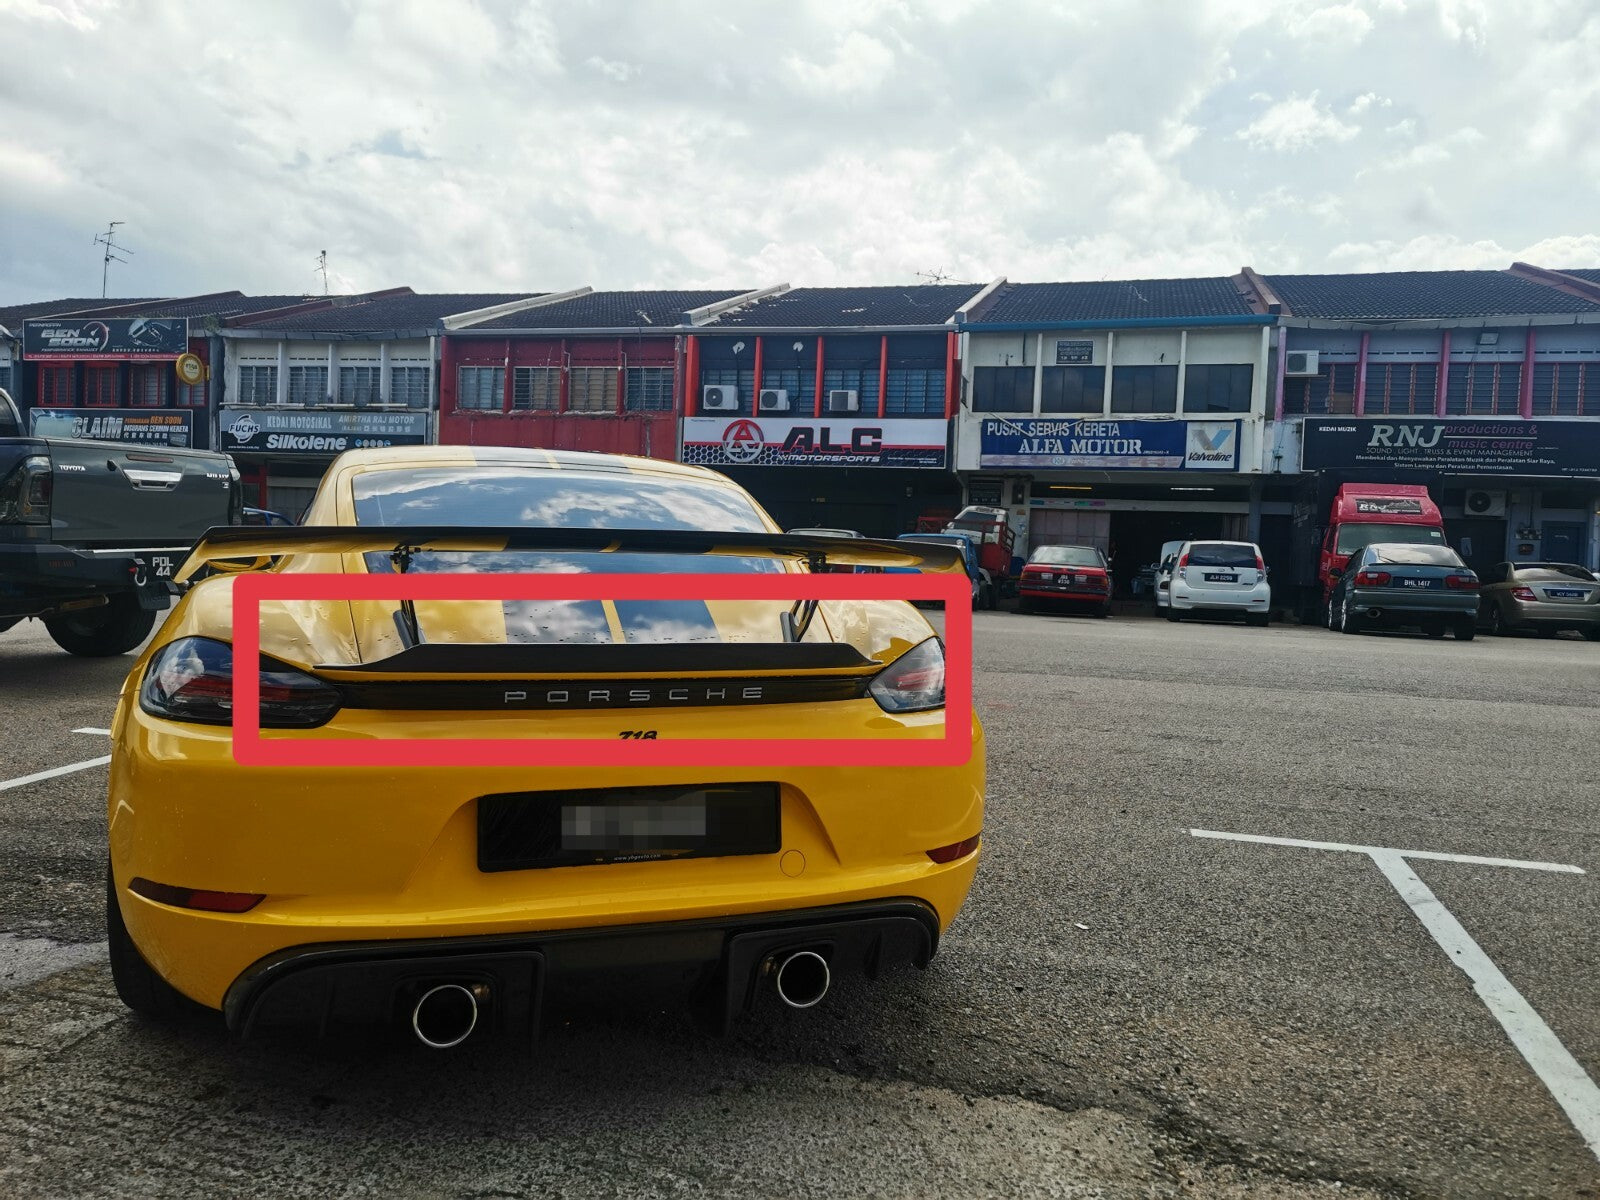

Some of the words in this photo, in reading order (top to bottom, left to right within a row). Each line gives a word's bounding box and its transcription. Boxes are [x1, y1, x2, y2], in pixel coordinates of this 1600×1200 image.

[41, 329, 80, 338] BEN
[48, 337, 100, 347] SOON
[266, 415, 288, 428] KEDAI
[290, 416, 332, 429] MOTOSIKAL
[338, 414, 371, 424] AMIRTHA
[372, 415, 387, 424] RAJ
[388, 416, 415, 424] MOTOR
[71, 416, 124, 439] CLAIM
[229, 424, 260, 433] FUCHS
[987, 422, 1024, 436] PUSAT
[1028, 422, 1070, 437] SERVIS
[1074, 422, 1120, 437] KERETA
[1444, 424, 1524, 435] productions
[1528, 424, 1538, 435] &
[780, 426, 883, 454] ALC
[1367, 424, 1446, 448] RNJ
[266, 434, 346, 450] Silkolene
[1018, 438, 1065, 454] ALFA
[1070, 438, 1142, 454] MOTOR
[1447, 439, 1488, 449] music
[1491, 440, 1533, 449] centre
[788, 454, 881, 463] MOTORSPORTS
[1187, 451, 1233, 462] Valvoline
[1477, 449, 1534, 457] MANAGEMENT
[155, 566, 171, 577] 44
[504, 686, 763, 703] PORSCHE
